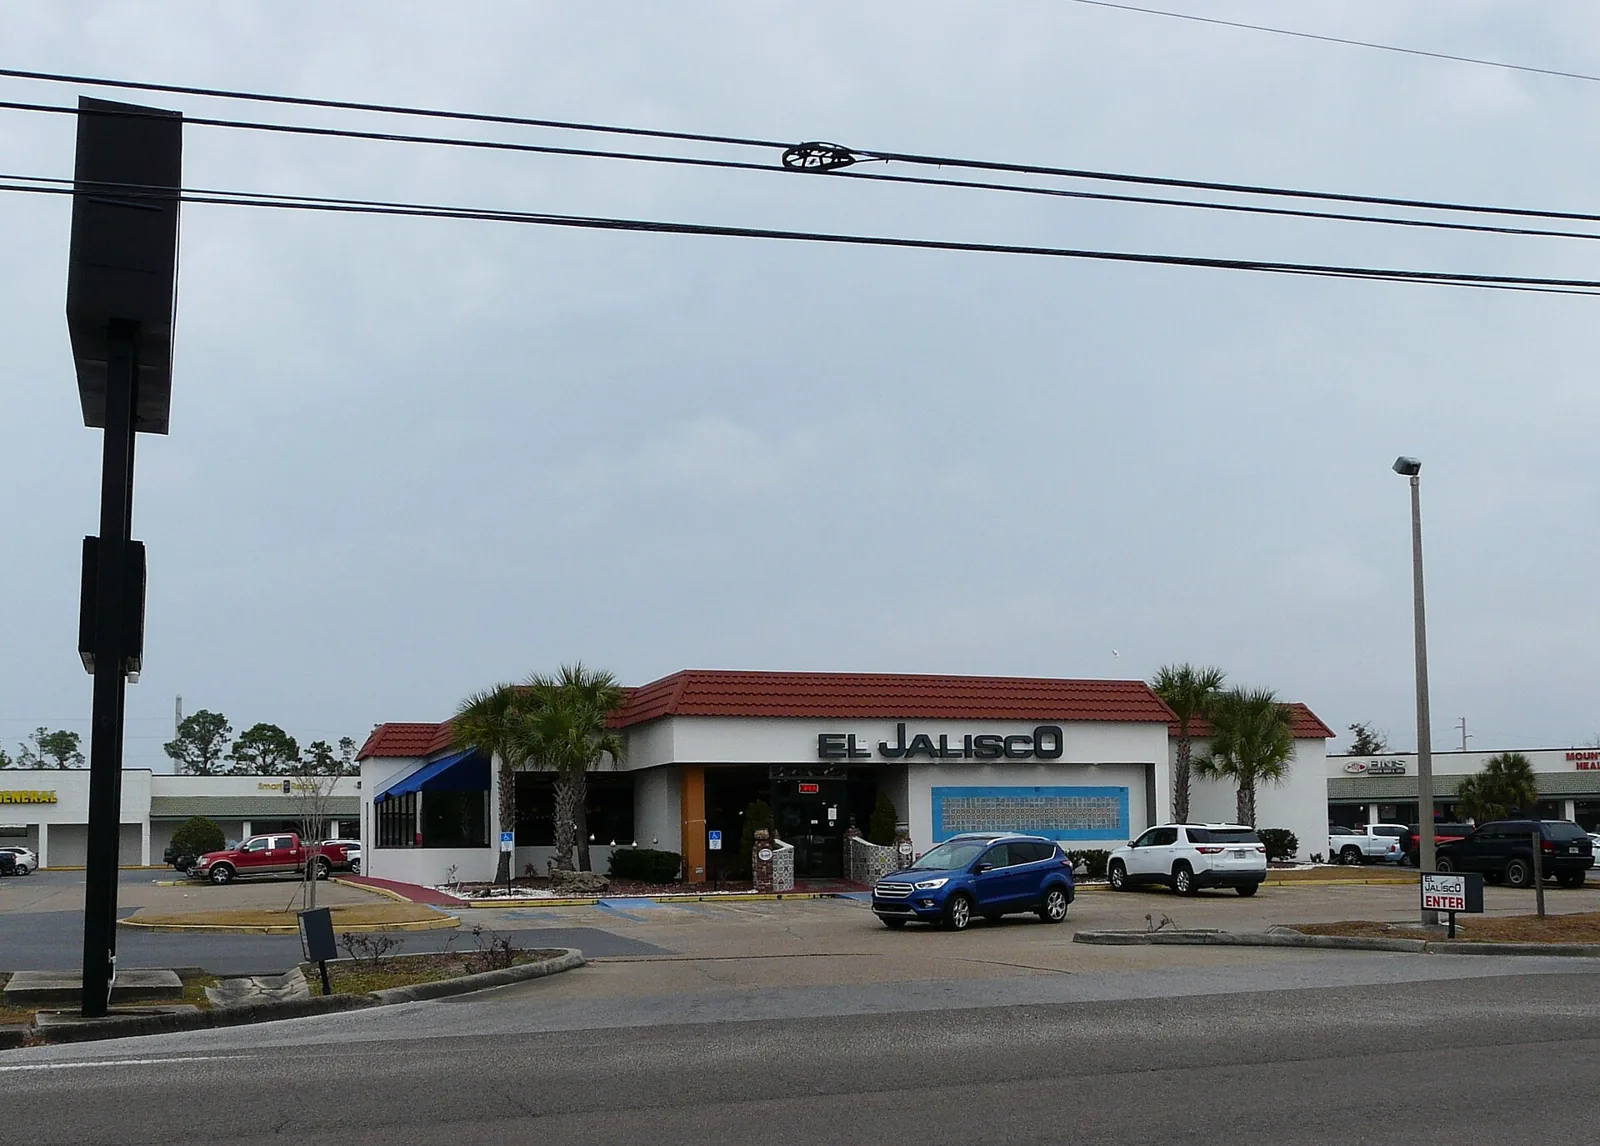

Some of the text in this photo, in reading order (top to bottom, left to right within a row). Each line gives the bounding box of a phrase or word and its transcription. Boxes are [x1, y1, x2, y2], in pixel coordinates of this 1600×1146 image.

[817, 722, 1063, 759] EL JALISCO
[1565, 752, 1600, 761] MOUN
[0, 790, 57, 804] ENERAL
[1424, 875, 1435, 883] EL
[1424, 882, 1462, 893] JALISCO
[1425, 895, 1464, 909] ENTER
